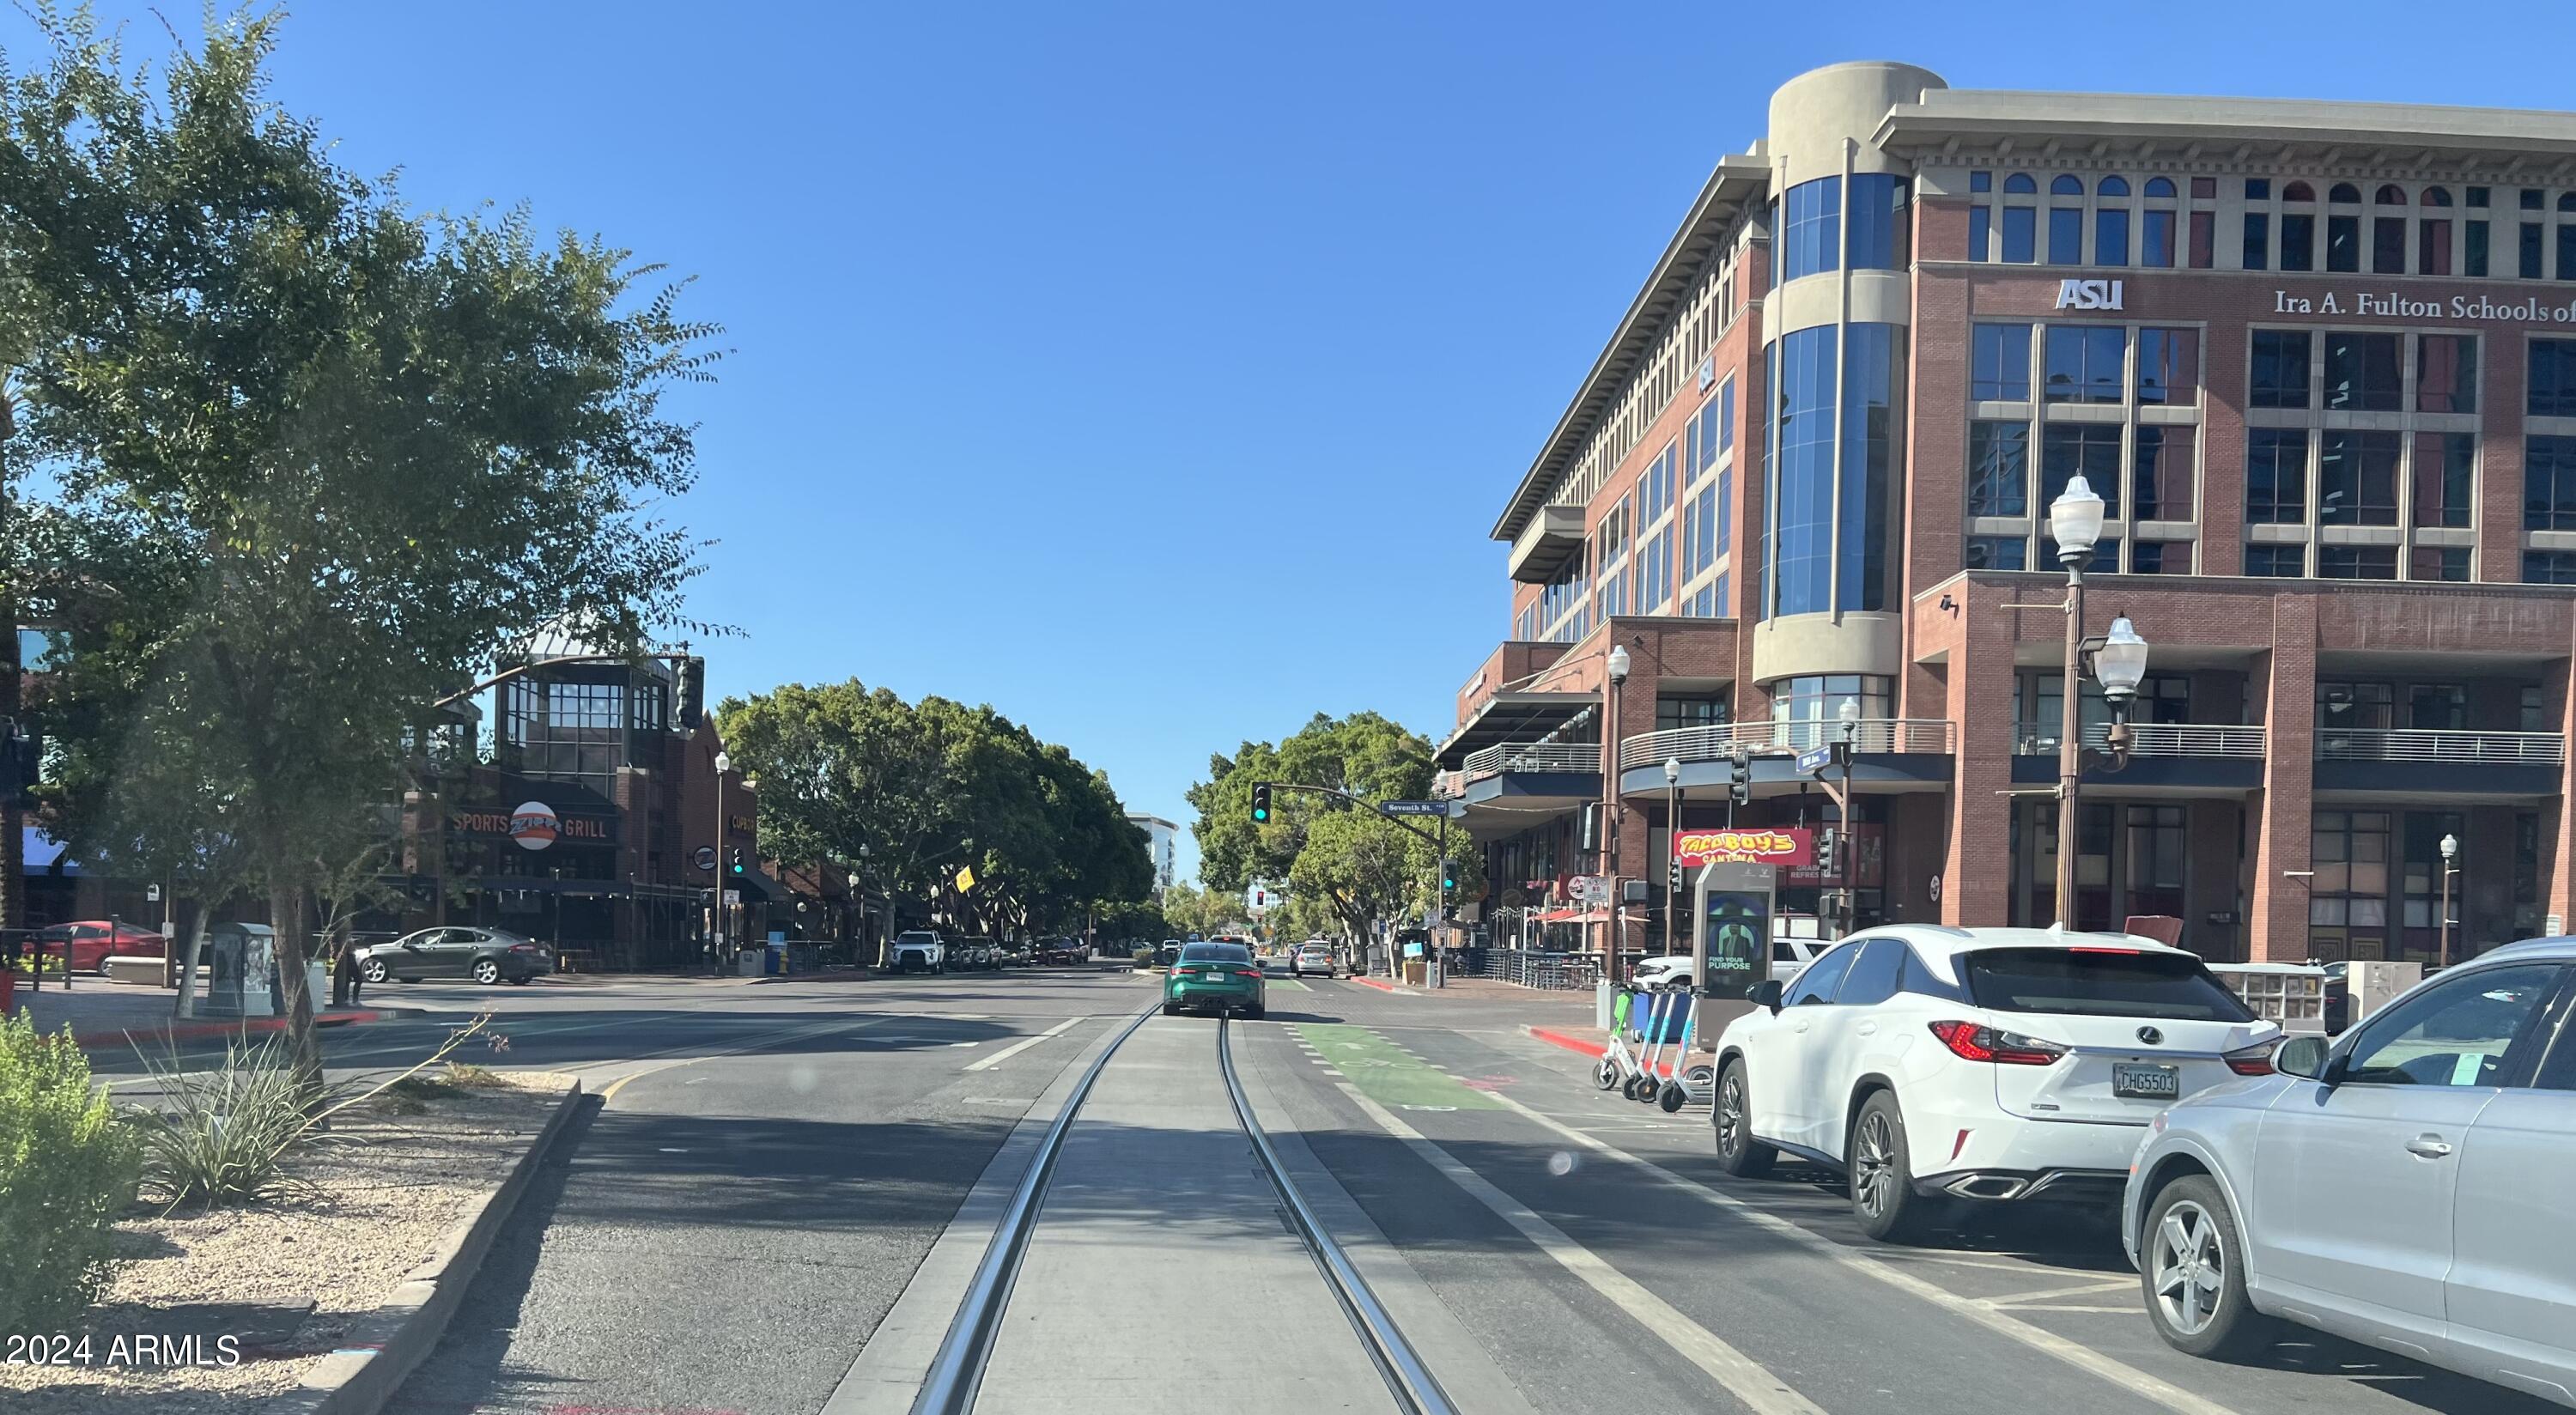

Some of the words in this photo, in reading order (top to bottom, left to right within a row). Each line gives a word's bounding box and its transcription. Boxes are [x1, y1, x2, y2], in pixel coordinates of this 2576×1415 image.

[2055, 279, 2123, 310] ASU
[2274, 290, 2312, 314] Ira
[2318, 291, 2347, 314] A.
[2356, 292, 2444, 318] Fulton
[2451, 295, 2549, 322] Schools
[2553, 299, 2576, 323] of
[453, 813, 508, 833] SPORTS
[565, 819, 606, 838] GRILL
[1708, 962, 1751, 970] PURPOSE
[2121, 1072, 2175, 1092] CHG5503
